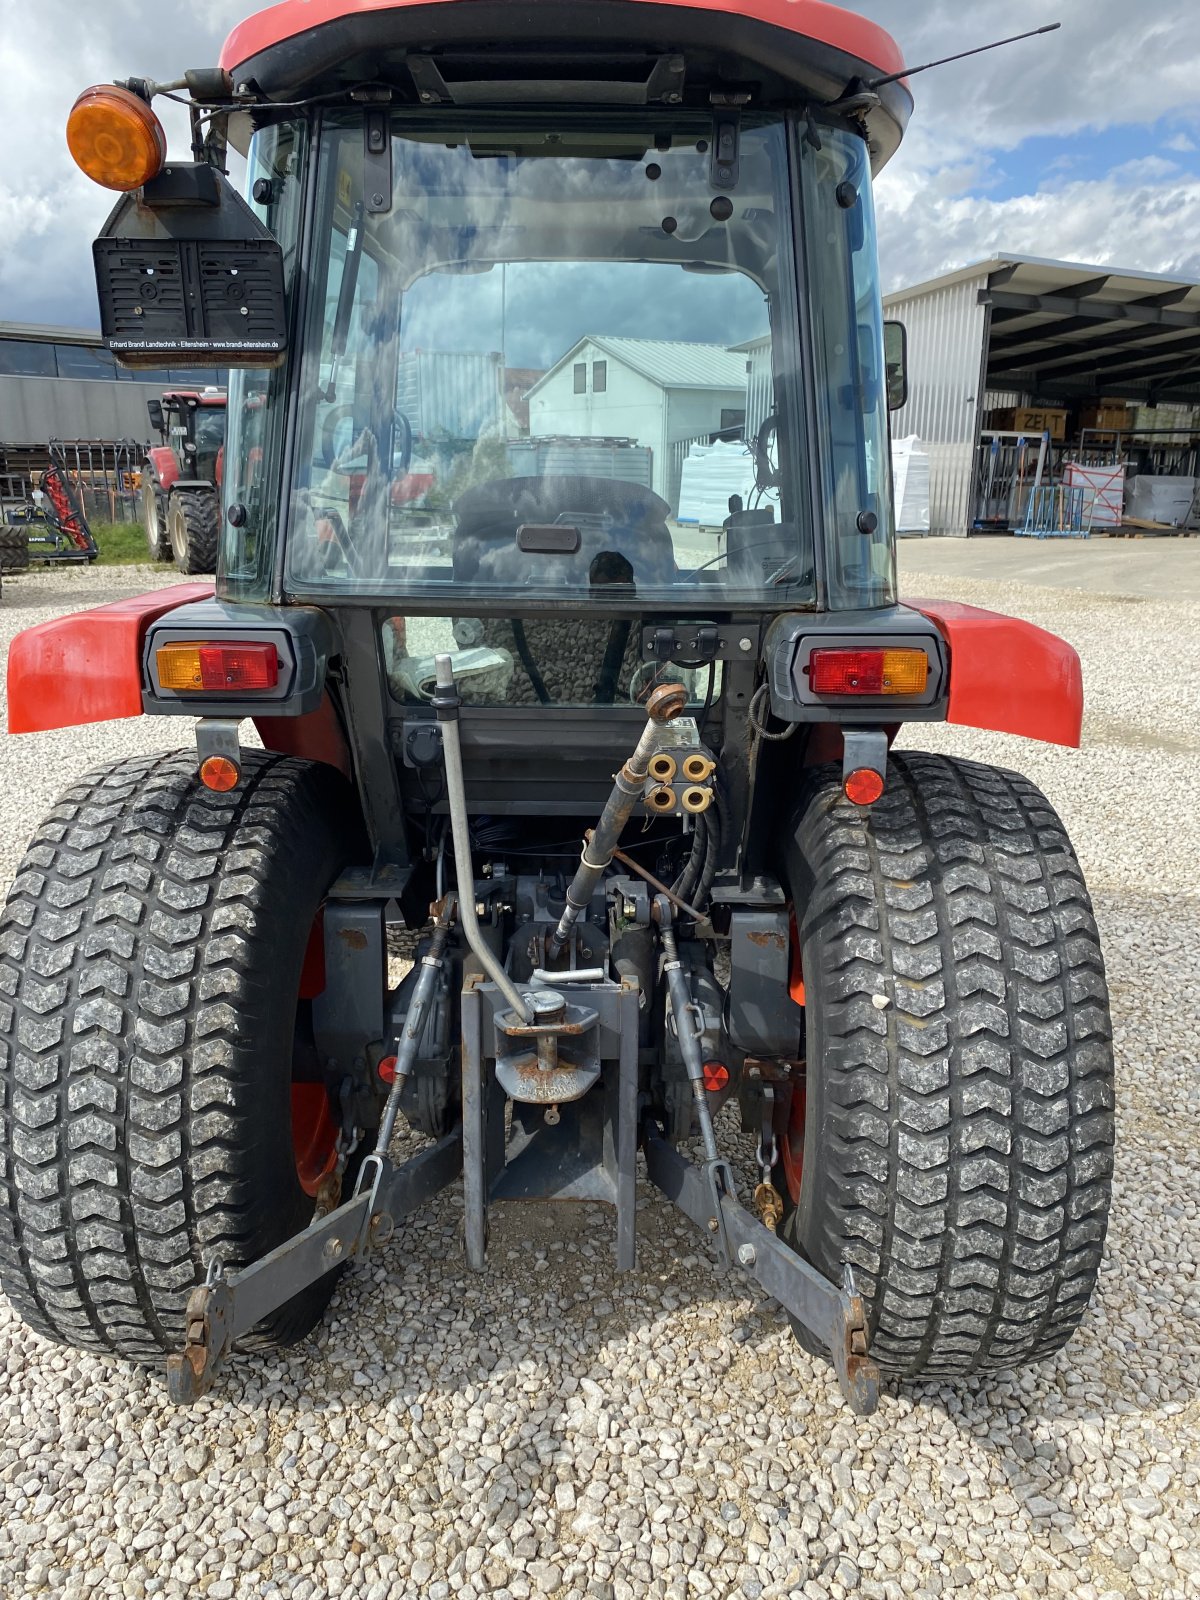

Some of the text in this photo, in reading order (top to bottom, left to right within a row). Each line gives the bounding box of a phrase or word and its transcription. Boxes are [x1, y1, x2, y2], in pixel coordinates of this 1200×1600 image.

[109, 340, 279, 348] Erhard Brandl Landtechnik Eitensheim www.brandl-eitensheim.de
